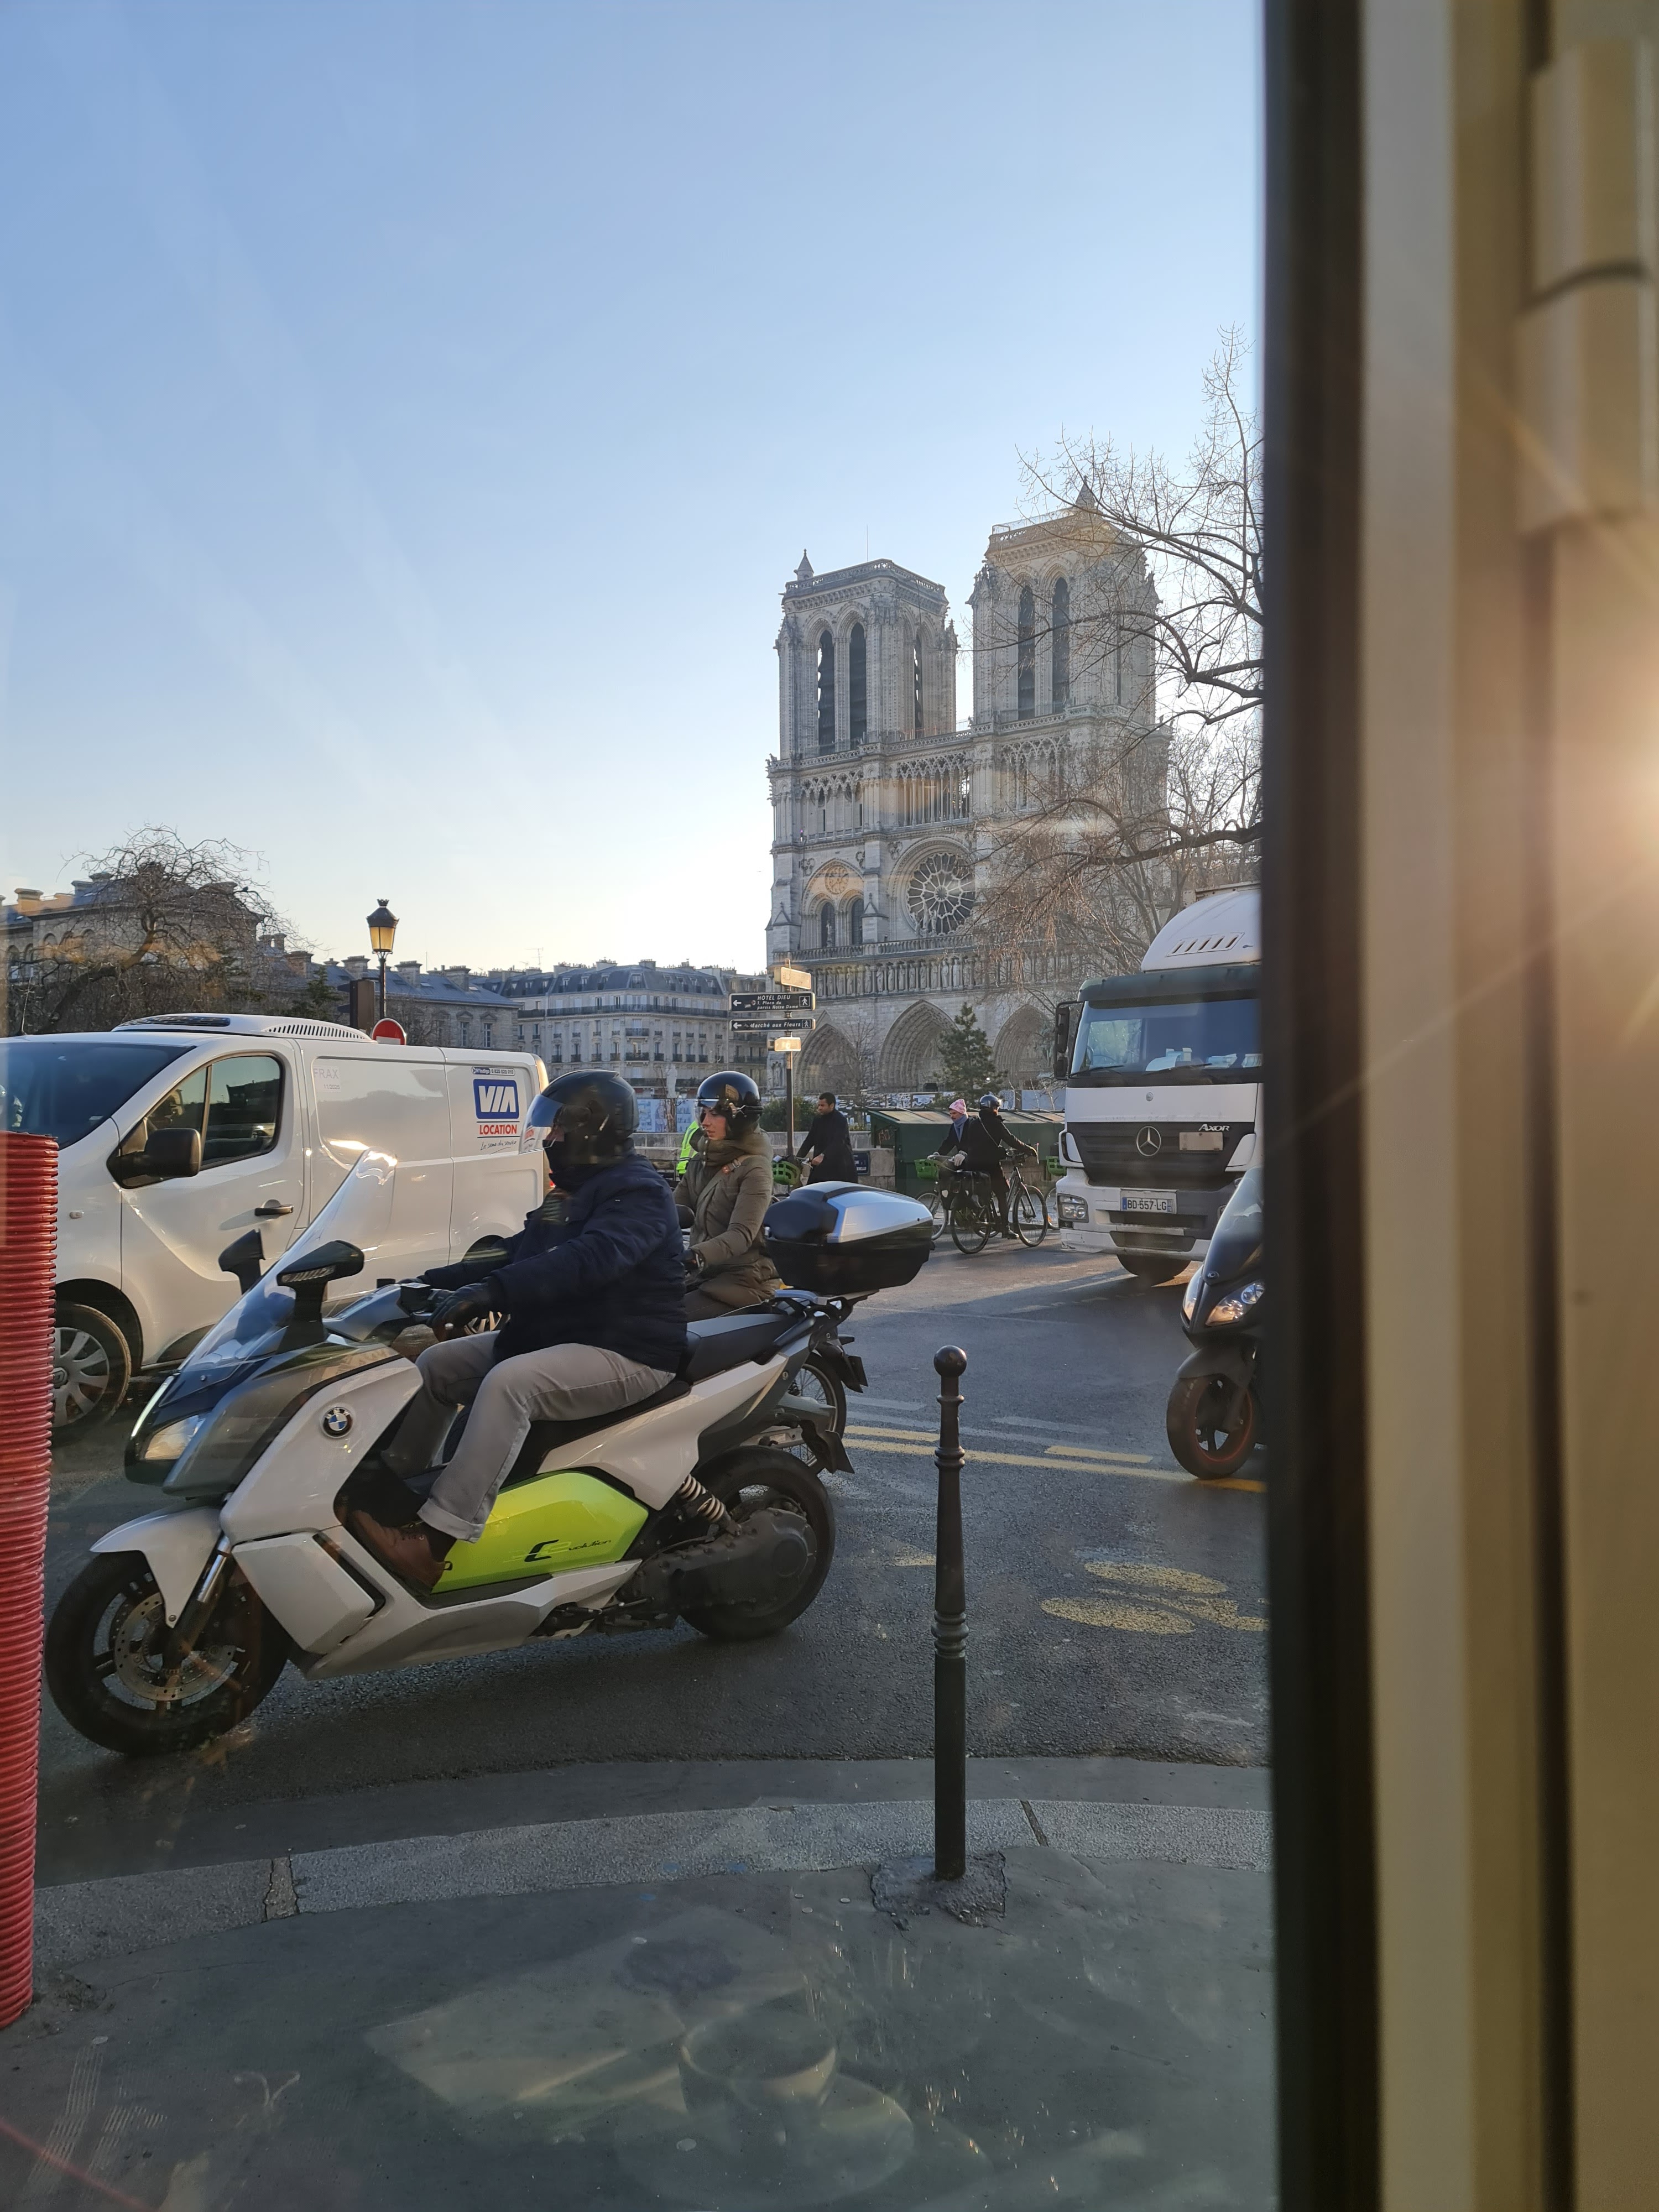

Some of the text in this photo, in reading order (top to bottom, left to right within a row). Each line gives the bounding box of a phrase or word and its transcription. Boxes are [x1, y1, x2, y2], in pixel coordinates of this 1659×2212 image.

[314, 1068, 338, 1078] FRAX
[478, 1086, 516, 1113] VIA
[479, 1124, 517, 1135] LOCATION
[327, 1408, 350, 1418] BMW
